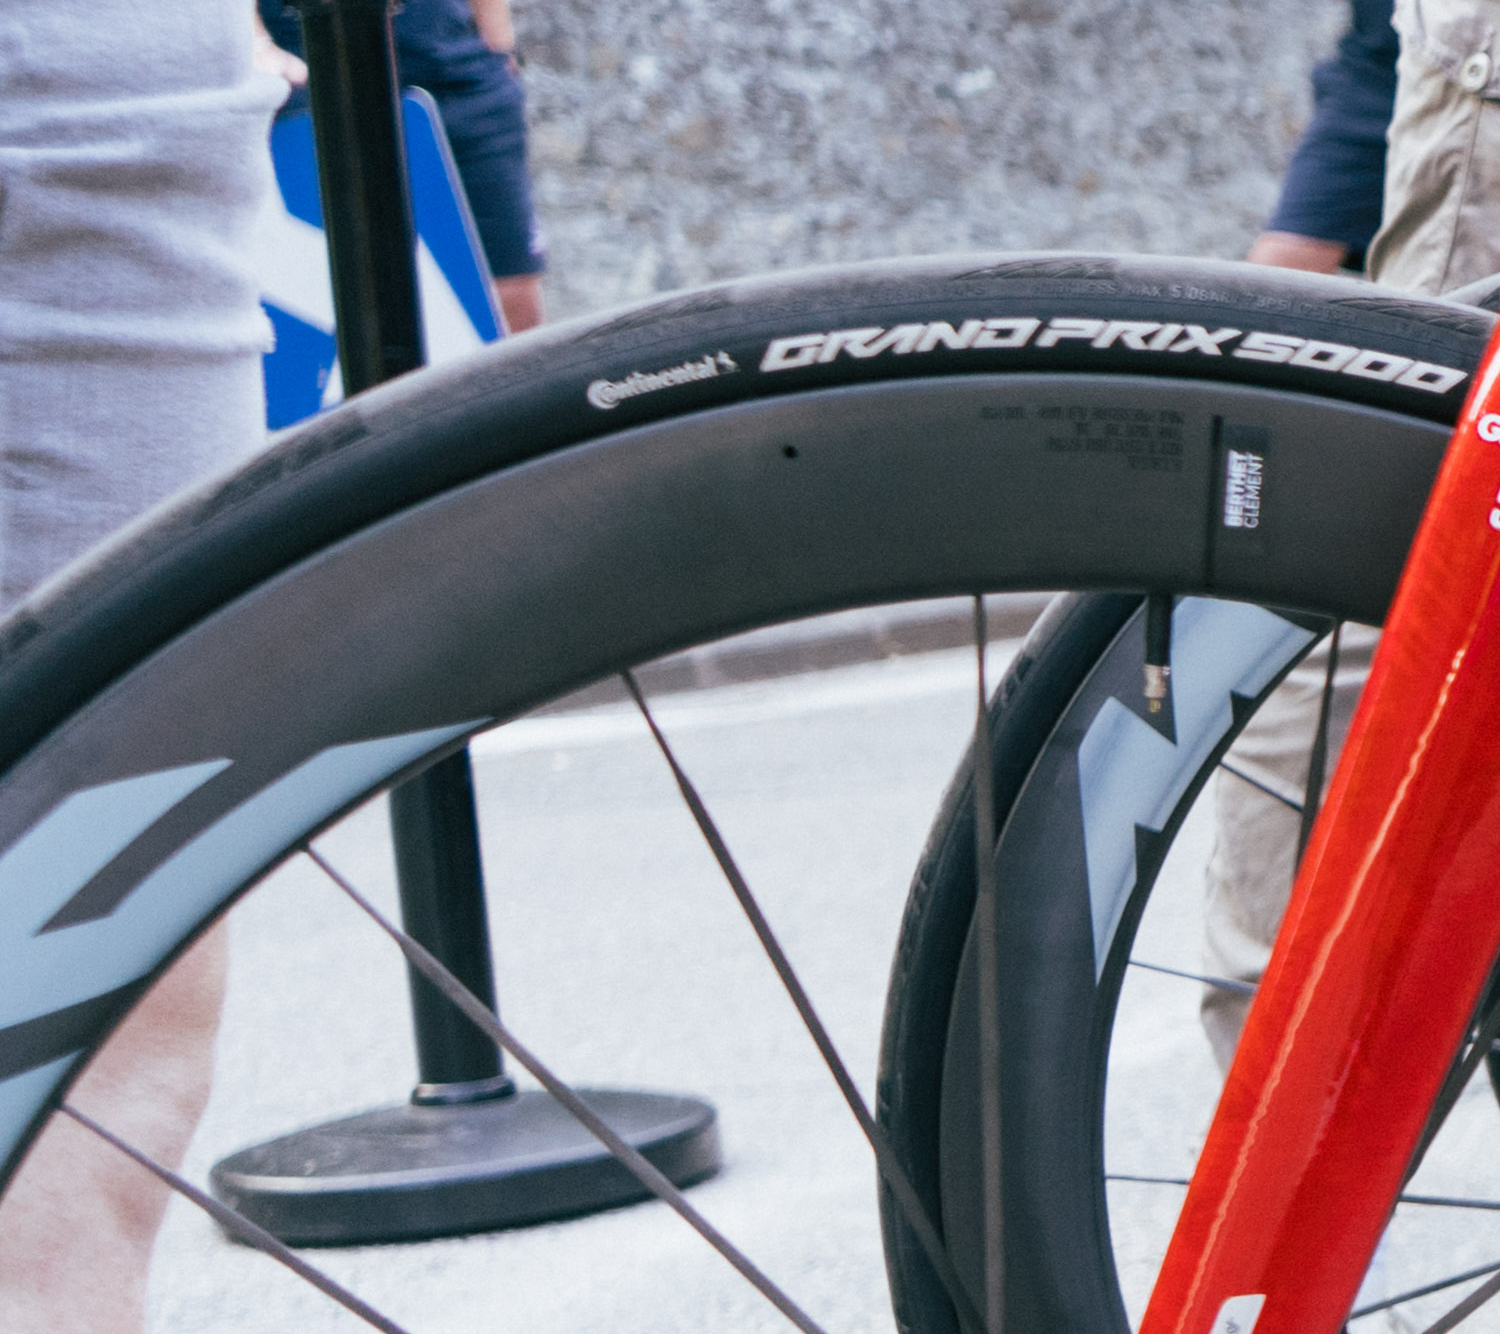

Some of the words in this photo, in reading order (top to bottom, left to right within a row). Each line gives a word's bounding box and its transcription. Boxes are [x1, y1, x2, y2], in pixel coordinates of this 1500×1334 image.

[759, 317, 1041, 372] GRAND
[1036, 317, 1242, 356] PRIX
[1231, 330, 1469, 394] 5000
[1243, 451, 1264, 529] CLEMENT
